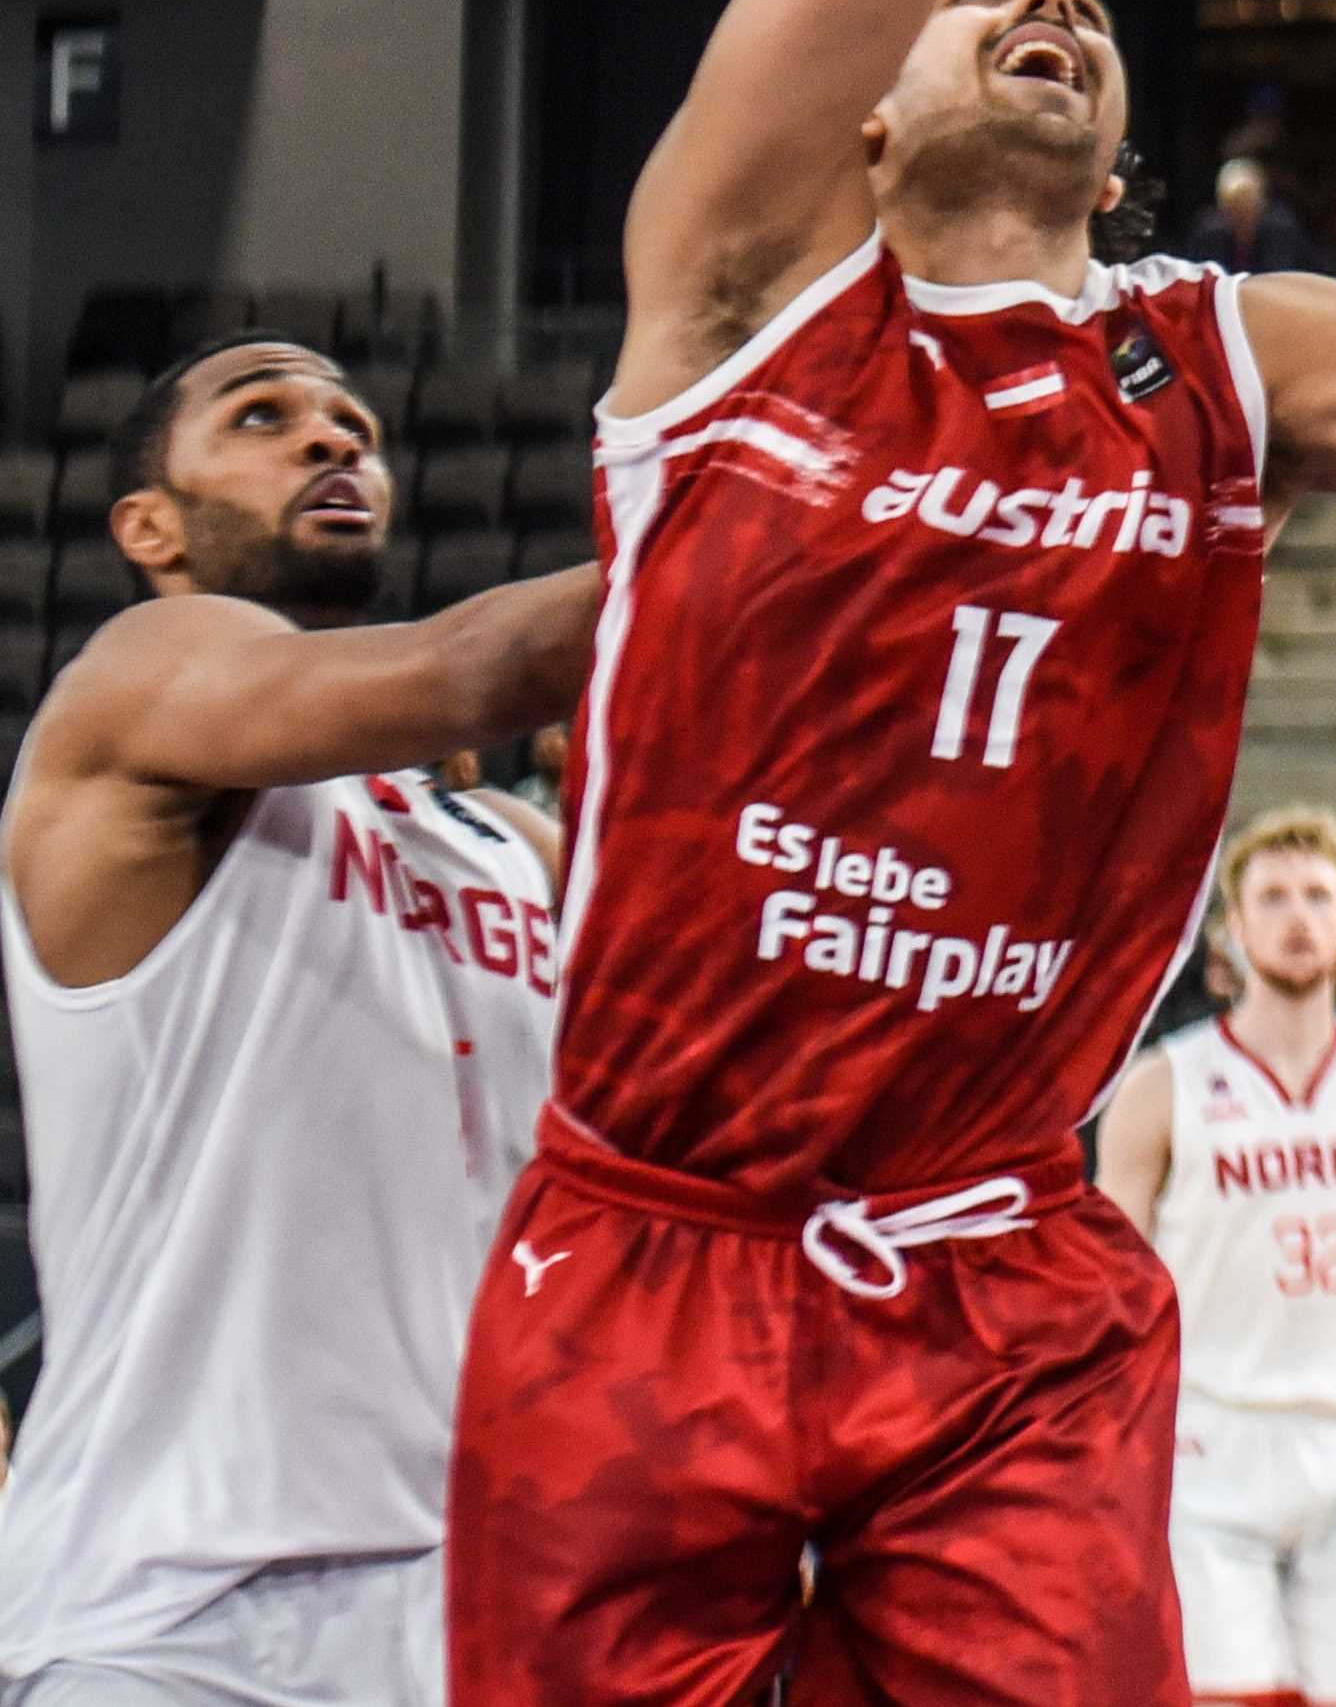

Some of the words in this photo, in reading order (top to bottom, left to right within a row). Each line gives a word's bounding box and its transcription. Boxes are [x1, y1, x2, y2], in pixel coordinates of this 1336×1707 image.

[49, 28, 106, 136] F
[862, 465, 1192, 558] austria
[930, 605, 1062, 769] 17
[736, 802, 816, 872] Es
[814, 836, 951, 911] lebe
[757, 890, 1075, 1013] Fairplay
